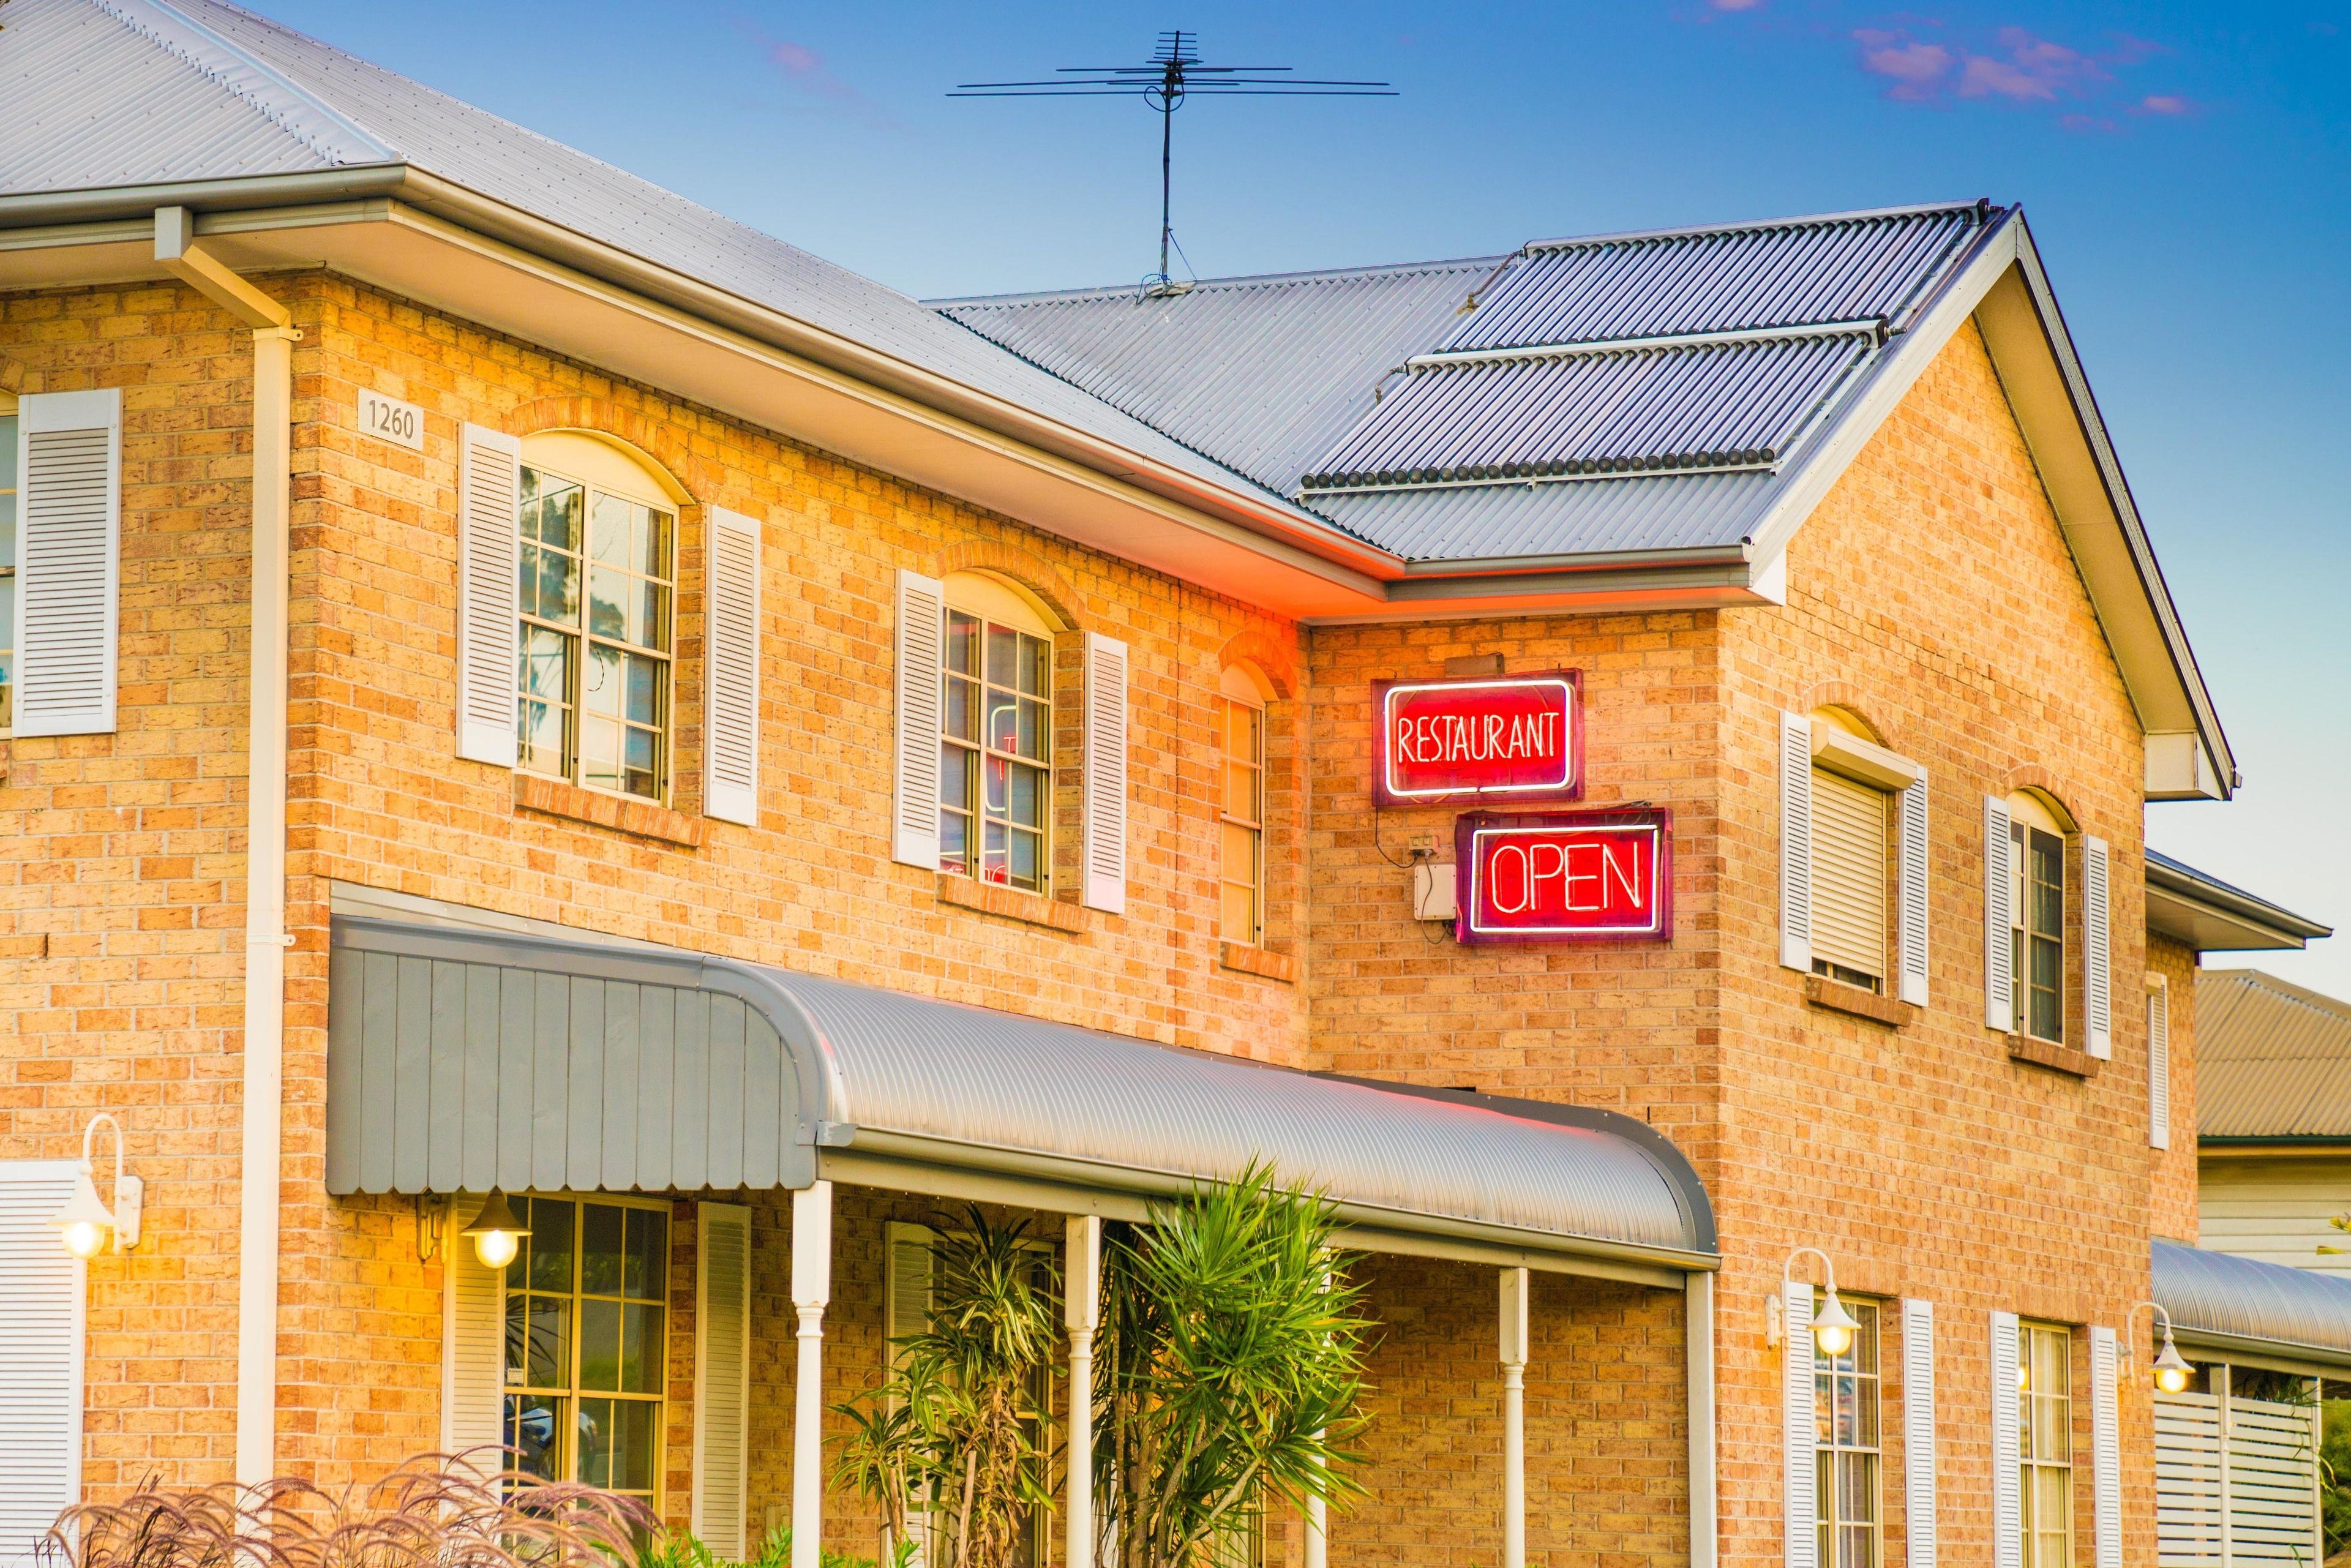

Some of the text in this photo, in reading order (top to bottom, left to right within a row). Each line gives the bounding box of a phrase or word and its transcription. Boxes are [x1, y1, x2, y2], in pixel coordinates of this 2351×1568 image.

[369, 399, 413, 440] 1260
[1398, 712, 1560, 763] RESTAURANT
[1491, 841, 1641, 913] OPEN
